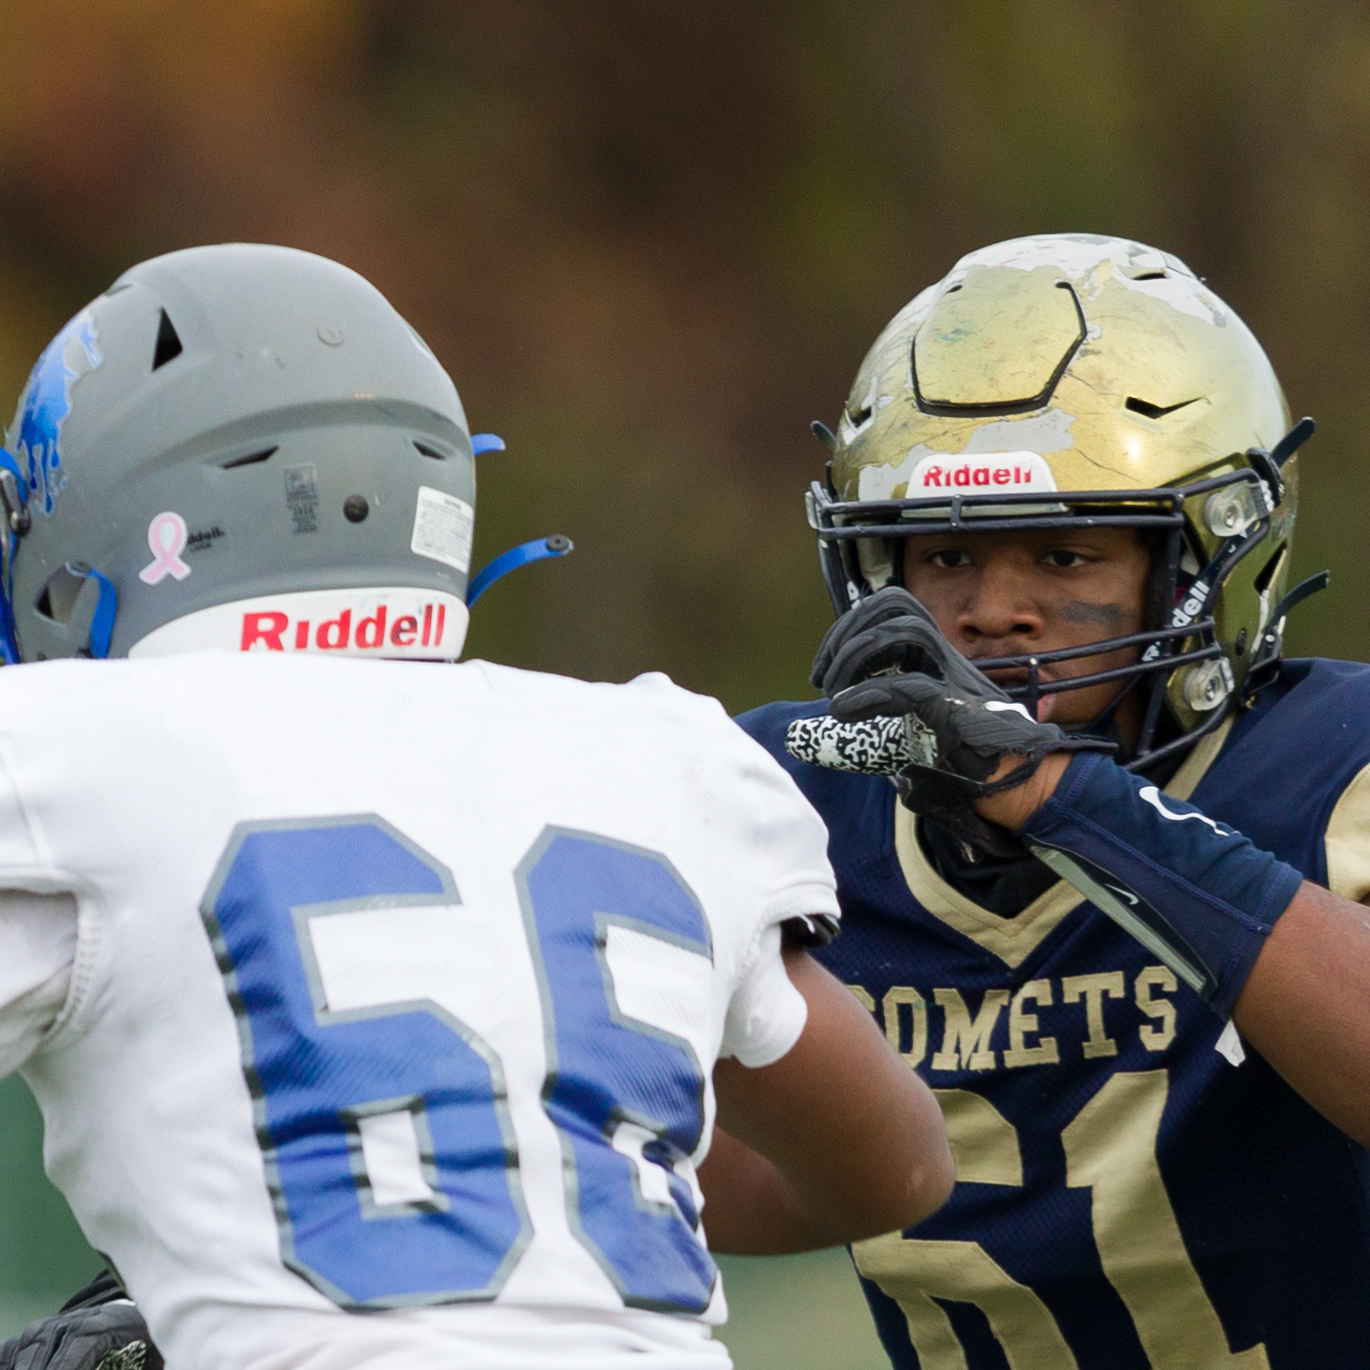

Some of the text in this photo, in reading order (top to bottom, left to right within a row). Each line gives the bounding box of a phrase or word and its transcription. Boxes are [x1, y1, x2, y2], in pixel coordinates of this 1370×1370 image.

[923, 464, 1032, 487] Riddell
[240, 602, 447, 652] Riddell
[845, 965, 1178, 1073] OMETS
[199, 812, 720, 1316] 66
